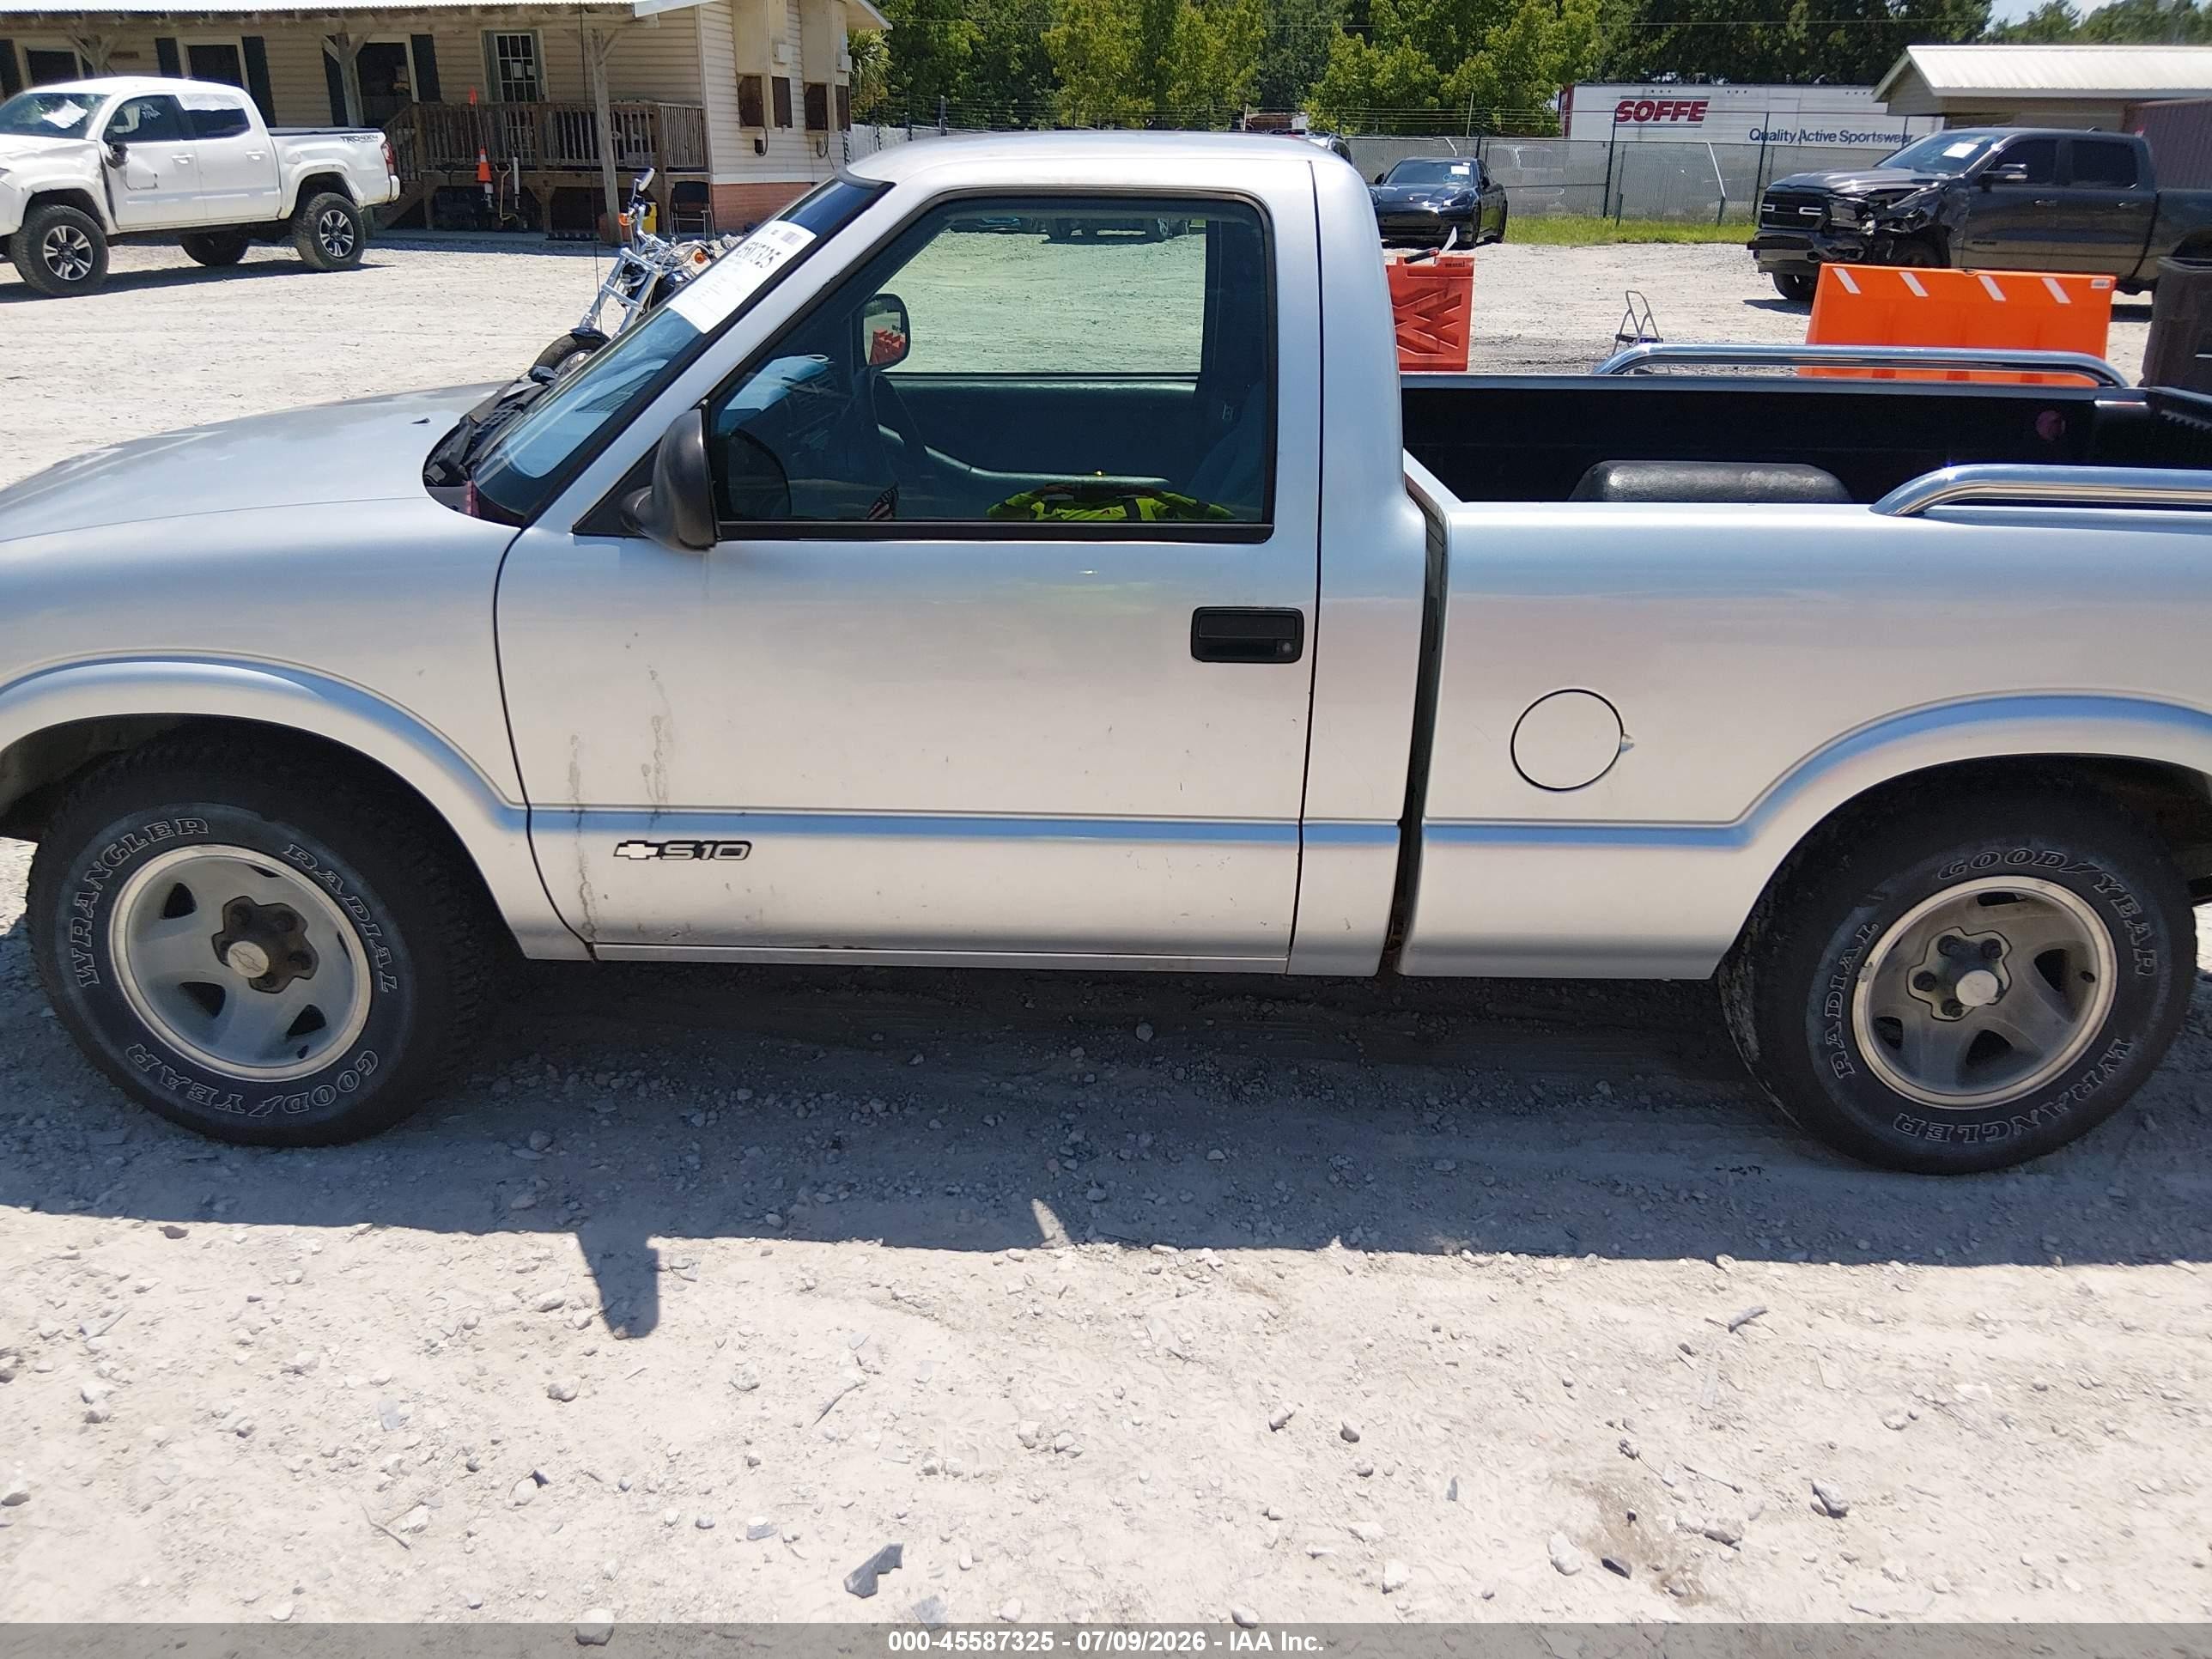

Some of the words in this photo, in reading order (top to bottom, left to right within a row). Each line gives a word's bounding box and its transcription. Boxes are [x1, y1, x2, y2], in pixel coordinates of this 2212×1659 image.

[1615, 100, 1709, 122] SOFFE
[1749, 128, 1796, 144] Quality
[1797, 129, 1837, 143] Active
[1839, 130, 1914, 144] Sportswear
[72, 817, 210, 988] WRANGLER
[661, 841, 753, 860] S10
[283, 843, 398, 993] RADIAL
[1825, 921, 1881, 1079] RADIAL
[1893, 1038, 2134, 1143] WRANGLER
